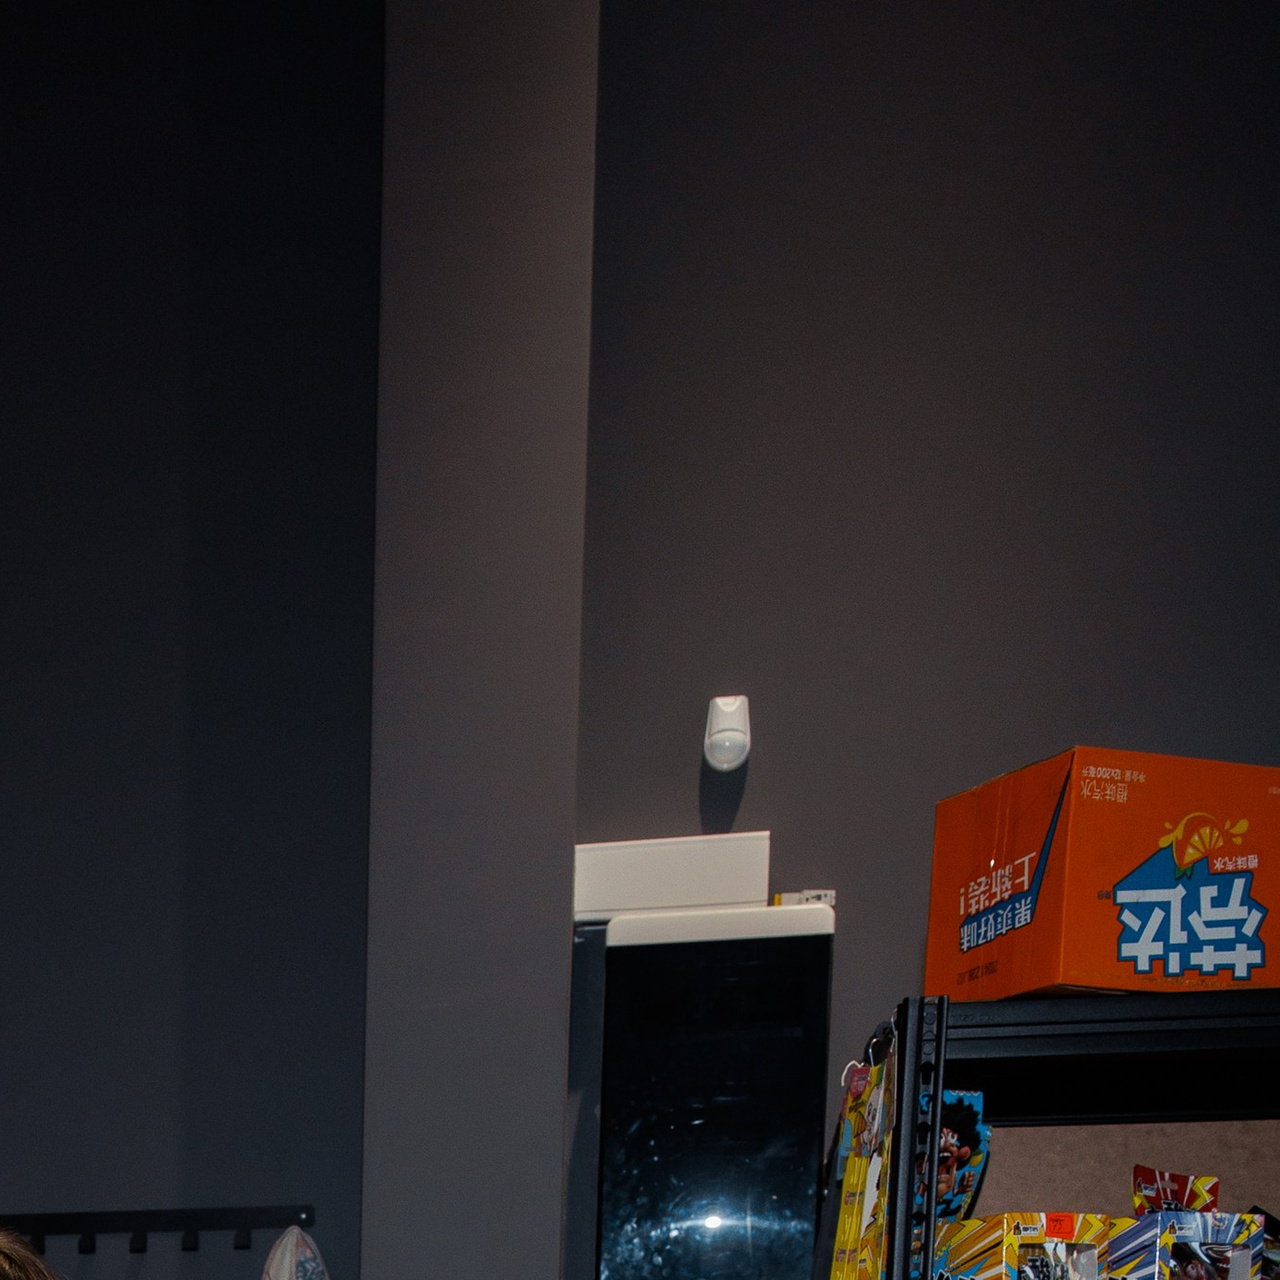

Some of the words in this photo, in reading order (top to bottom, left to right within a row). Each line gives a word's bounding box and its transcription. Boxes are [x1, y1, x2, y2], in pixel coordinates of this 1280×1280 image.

[1080, 779, 1128, 803] 橙味汽水
[1213, 853, 1259, 871] 橙味汽水
[959, 895, 1034, 954] 果爽好味
[1116, 877, 1263, 978] 芬达
